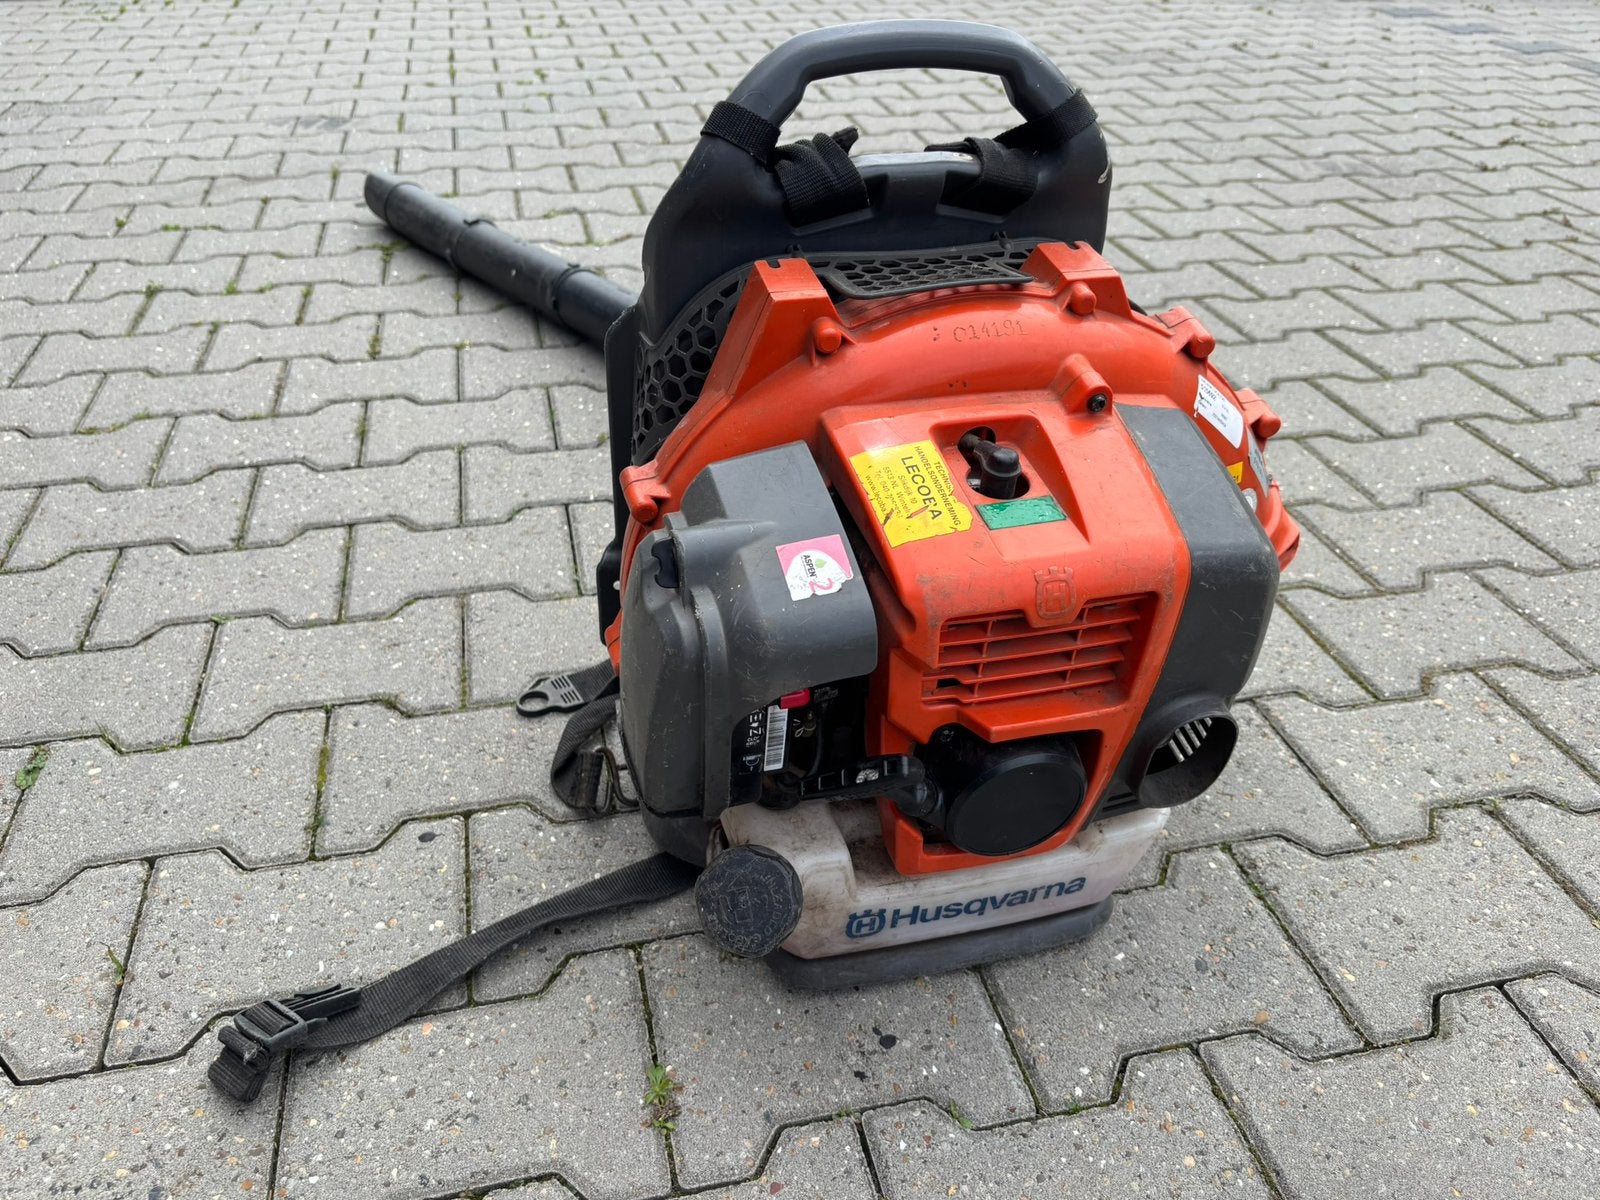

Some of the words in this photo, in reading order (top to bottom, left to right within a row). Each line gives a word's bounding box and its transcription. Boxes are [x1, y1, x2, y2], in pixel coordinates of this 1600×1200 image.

[914, 446, 961, 526] HANDELSONDERNEMING
[803, 554, 816, 578] ASPEN
[890, 876, 1087, 929] Husqvarna
